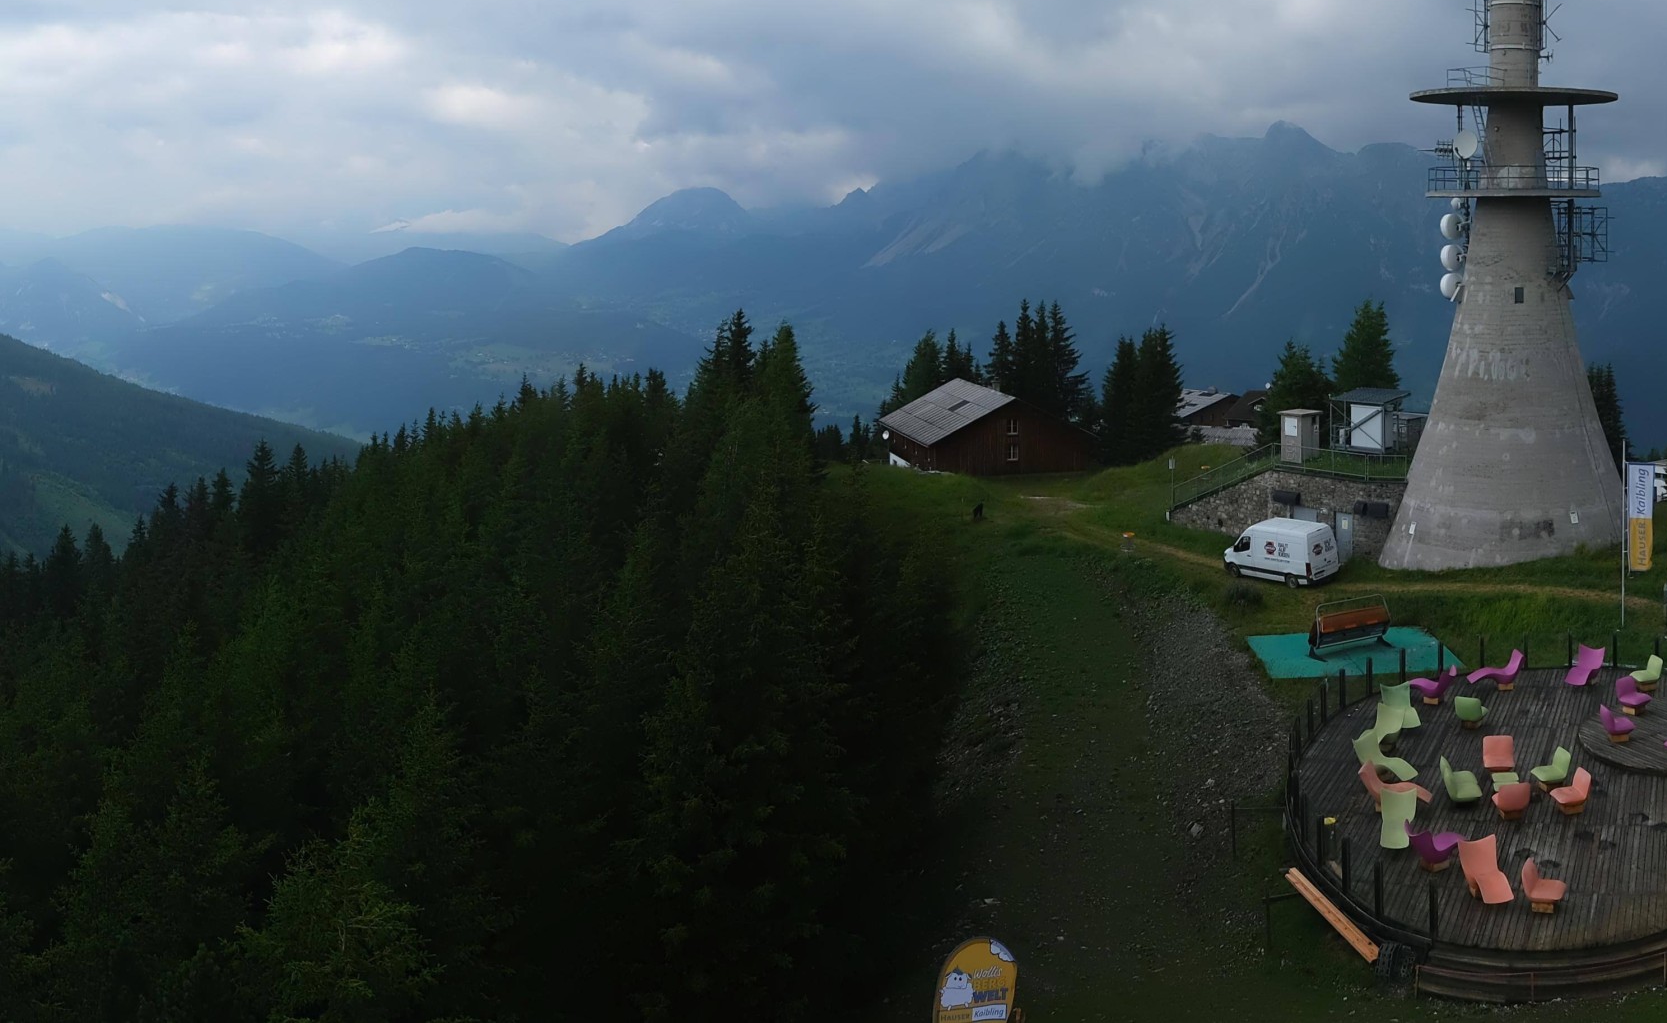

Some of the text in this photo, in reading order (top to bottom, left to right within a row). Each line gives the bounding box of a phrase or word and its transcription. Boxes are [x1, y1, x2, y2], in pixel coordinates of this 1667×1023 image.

[1635, 468, 1649, 566] HAUSER Kaibling
[973, 976, 1007, 990] BERG
[972, 987, 1009, 1003] WELT
[974, 1007, 1004, 1019] Kaibling
